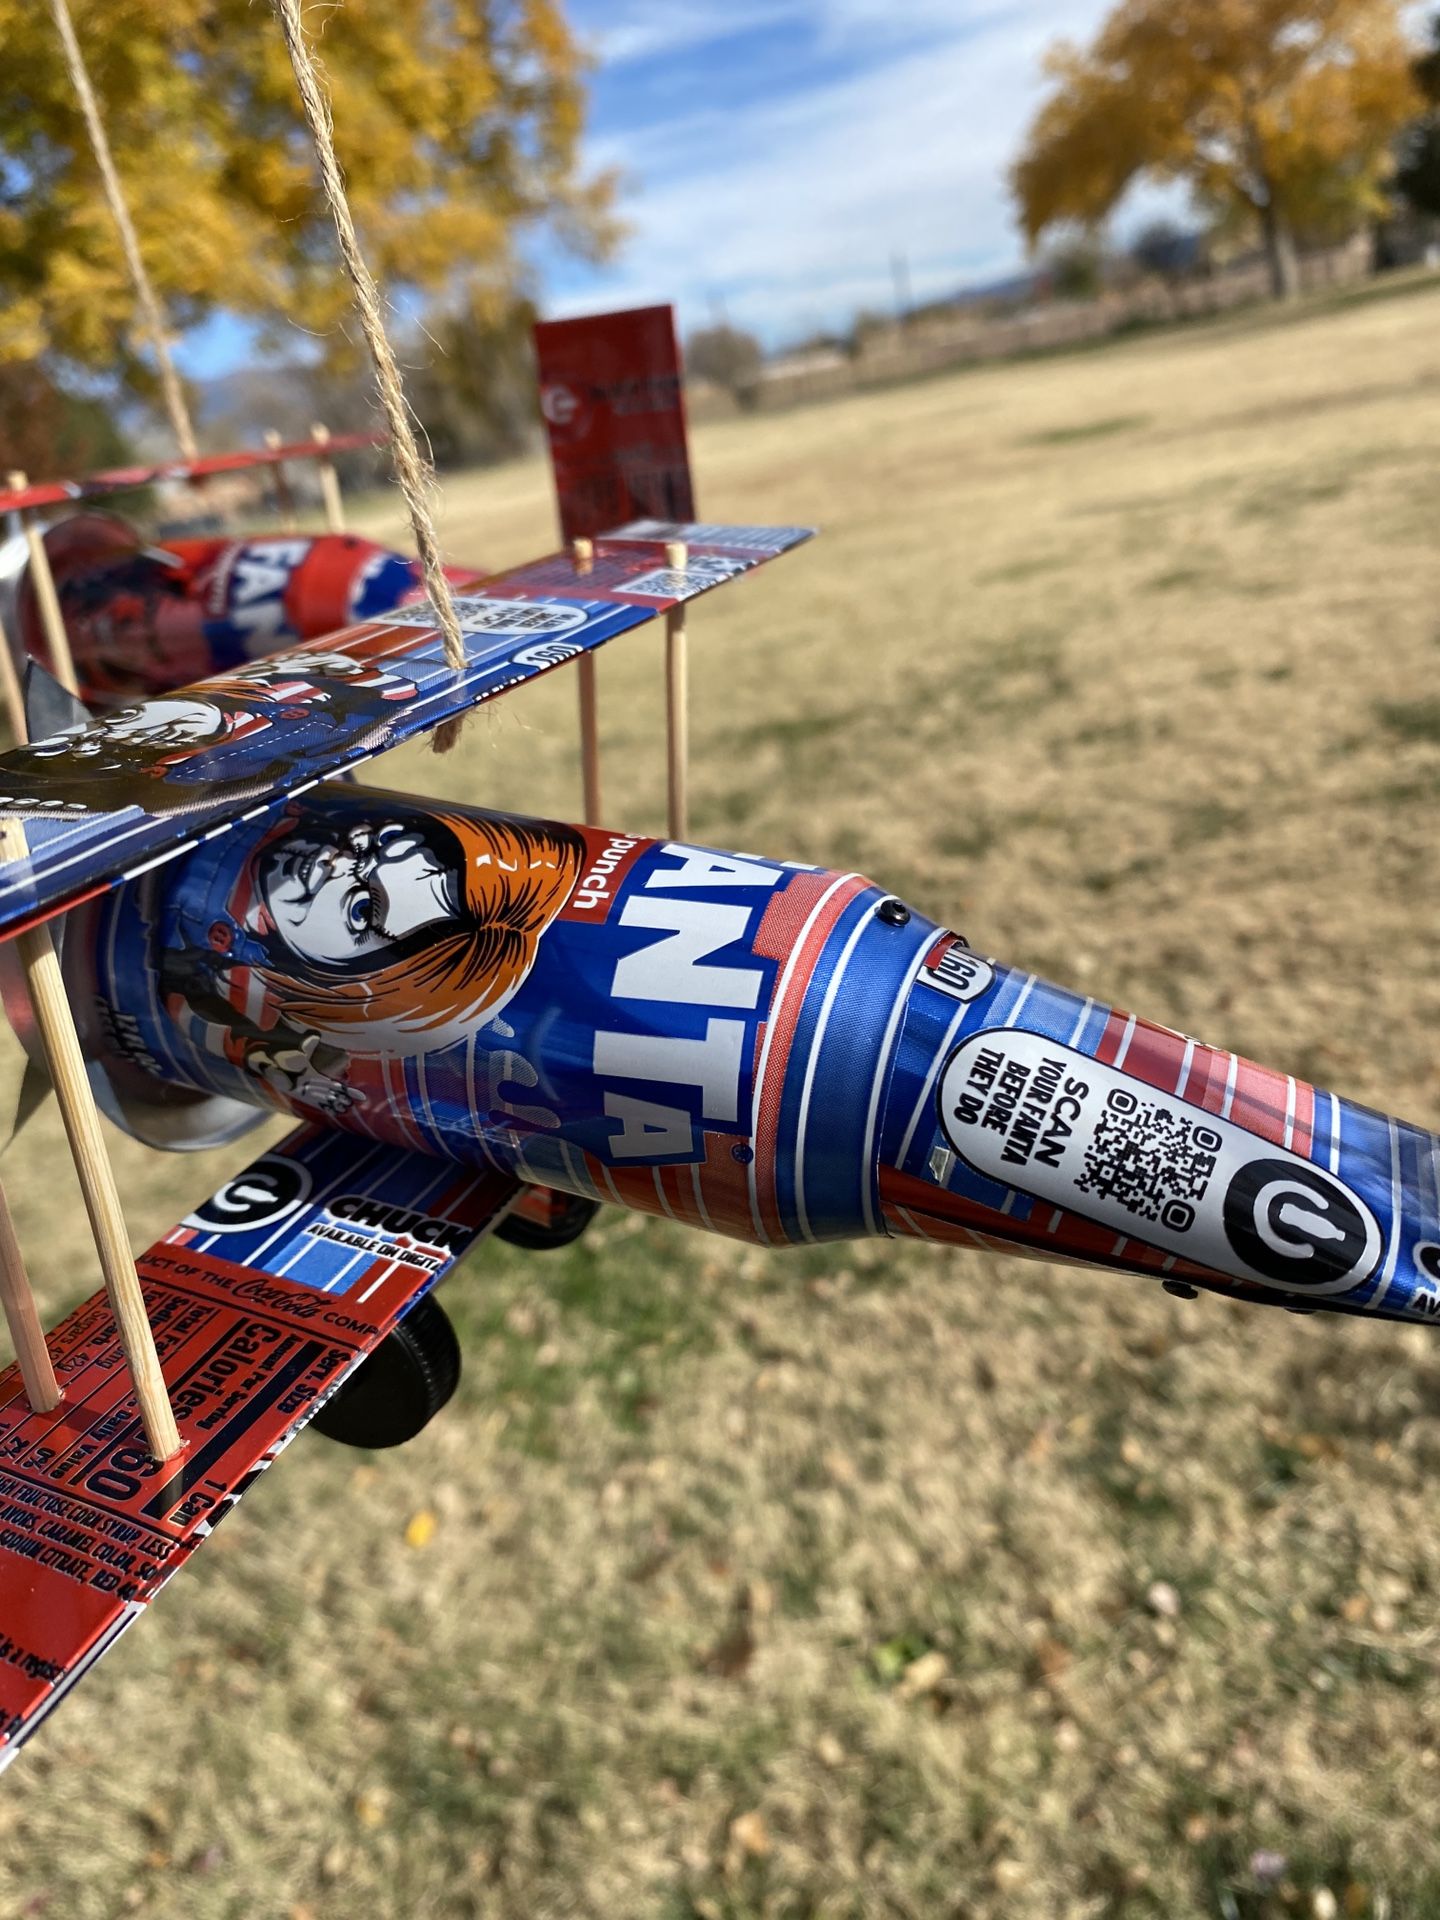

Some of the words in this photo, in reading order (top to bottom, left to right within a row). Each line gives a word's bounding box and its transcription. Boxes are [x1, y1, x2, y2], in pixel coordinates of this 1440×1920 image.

[573, 837, 638, 910] punch
[592, 843, 818, 1160] ANTA
[966, 1047, 1006, 1097] THEY
[1026, 1057, 1067, 1104] YOUR
[953, 1092, 984, 1125] DO
[981, 1060, 1031, 1136] BEFORE
[1000, 1101, 1047, 1166] FANTA
[1034, 1076, 1089, 1168] SCAN
[307, 1223, 380, 1252] AVAILABLE
[376, 1243, 400, 1258] ON
[174, 1264, 201, 1276] OF
[200, 1271, 237, 1288] THE
[61, 1310, 109, 1345] Sugars
[172, 1322, 282, 1421] Calories
[304, 1349, 352, 1385] Serv.
[276, 1383, 320, 1415] Size
[169, 1492, 216, 1526] Can
[138, 1536, 174, 1560] LESS
